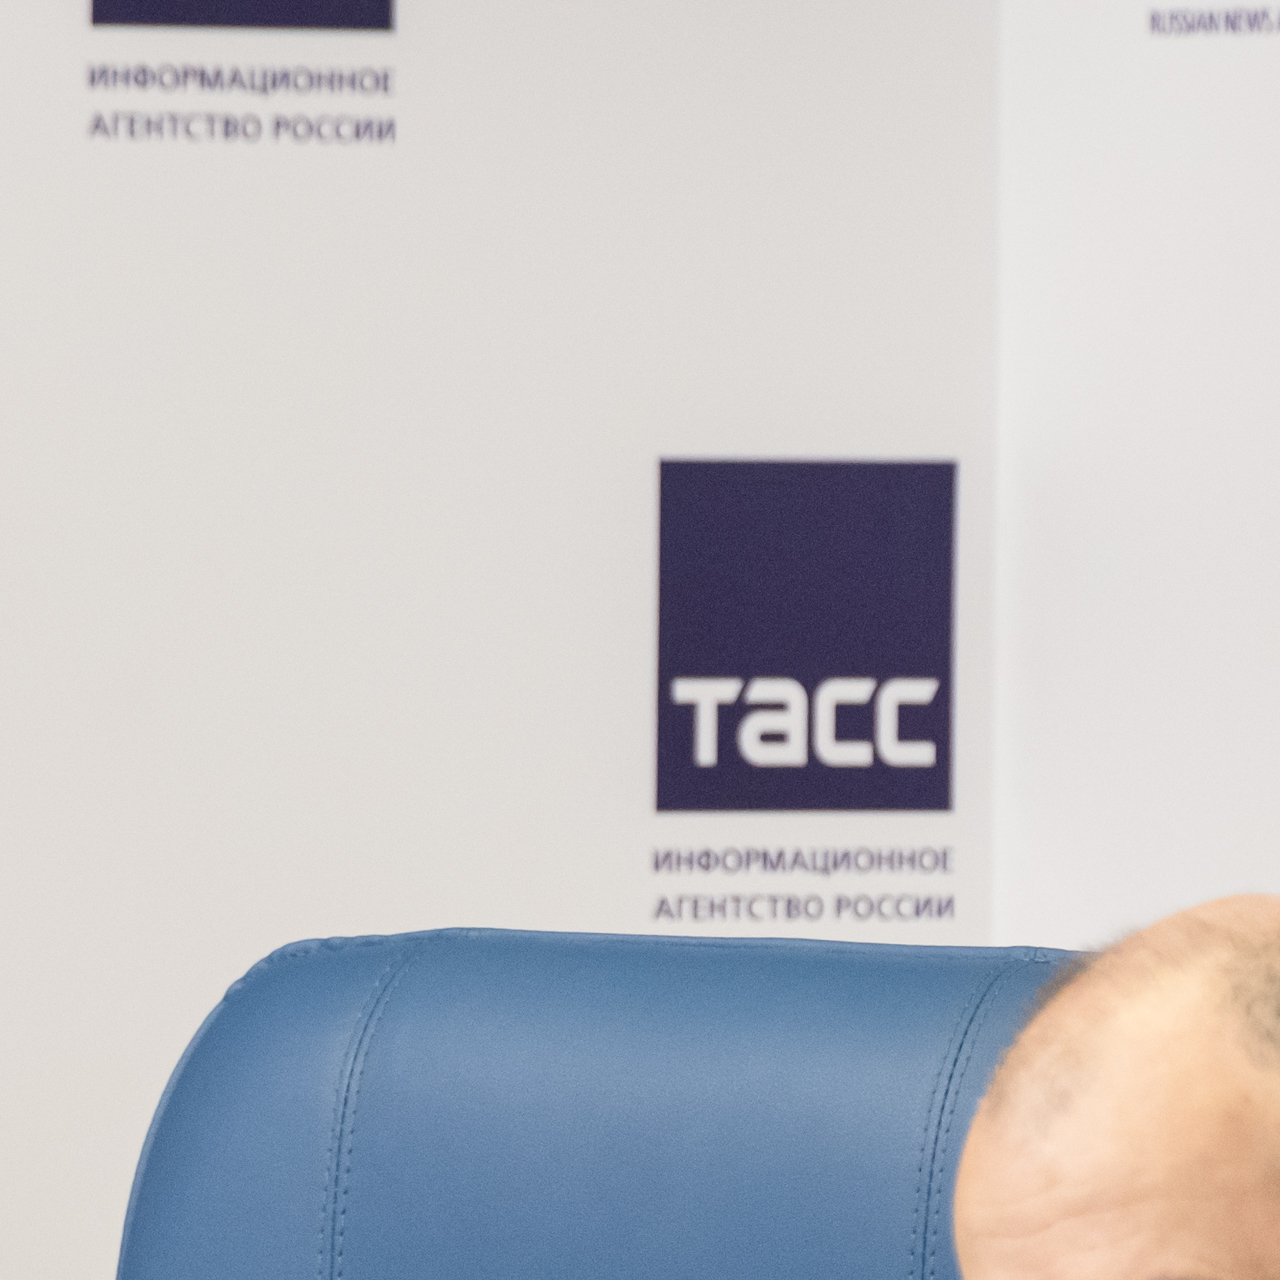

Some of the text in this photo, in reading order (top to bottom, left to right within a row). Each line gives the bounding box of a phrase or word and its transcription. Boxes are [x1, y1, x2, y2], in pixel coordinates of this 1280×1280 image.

[1224, 9, 1272, 34] NEWS
[88, 64, 392, 97] ИНФОРМАЦИОННОЕ
[88, 112, 397, 142] АГЕНТСТВО РОССИИ
[653, 847, 954, 878] ИНФОРМАЦИОННОЕ
[654, 895, 956, 921] АГЕНТСТВО РОССИИ
